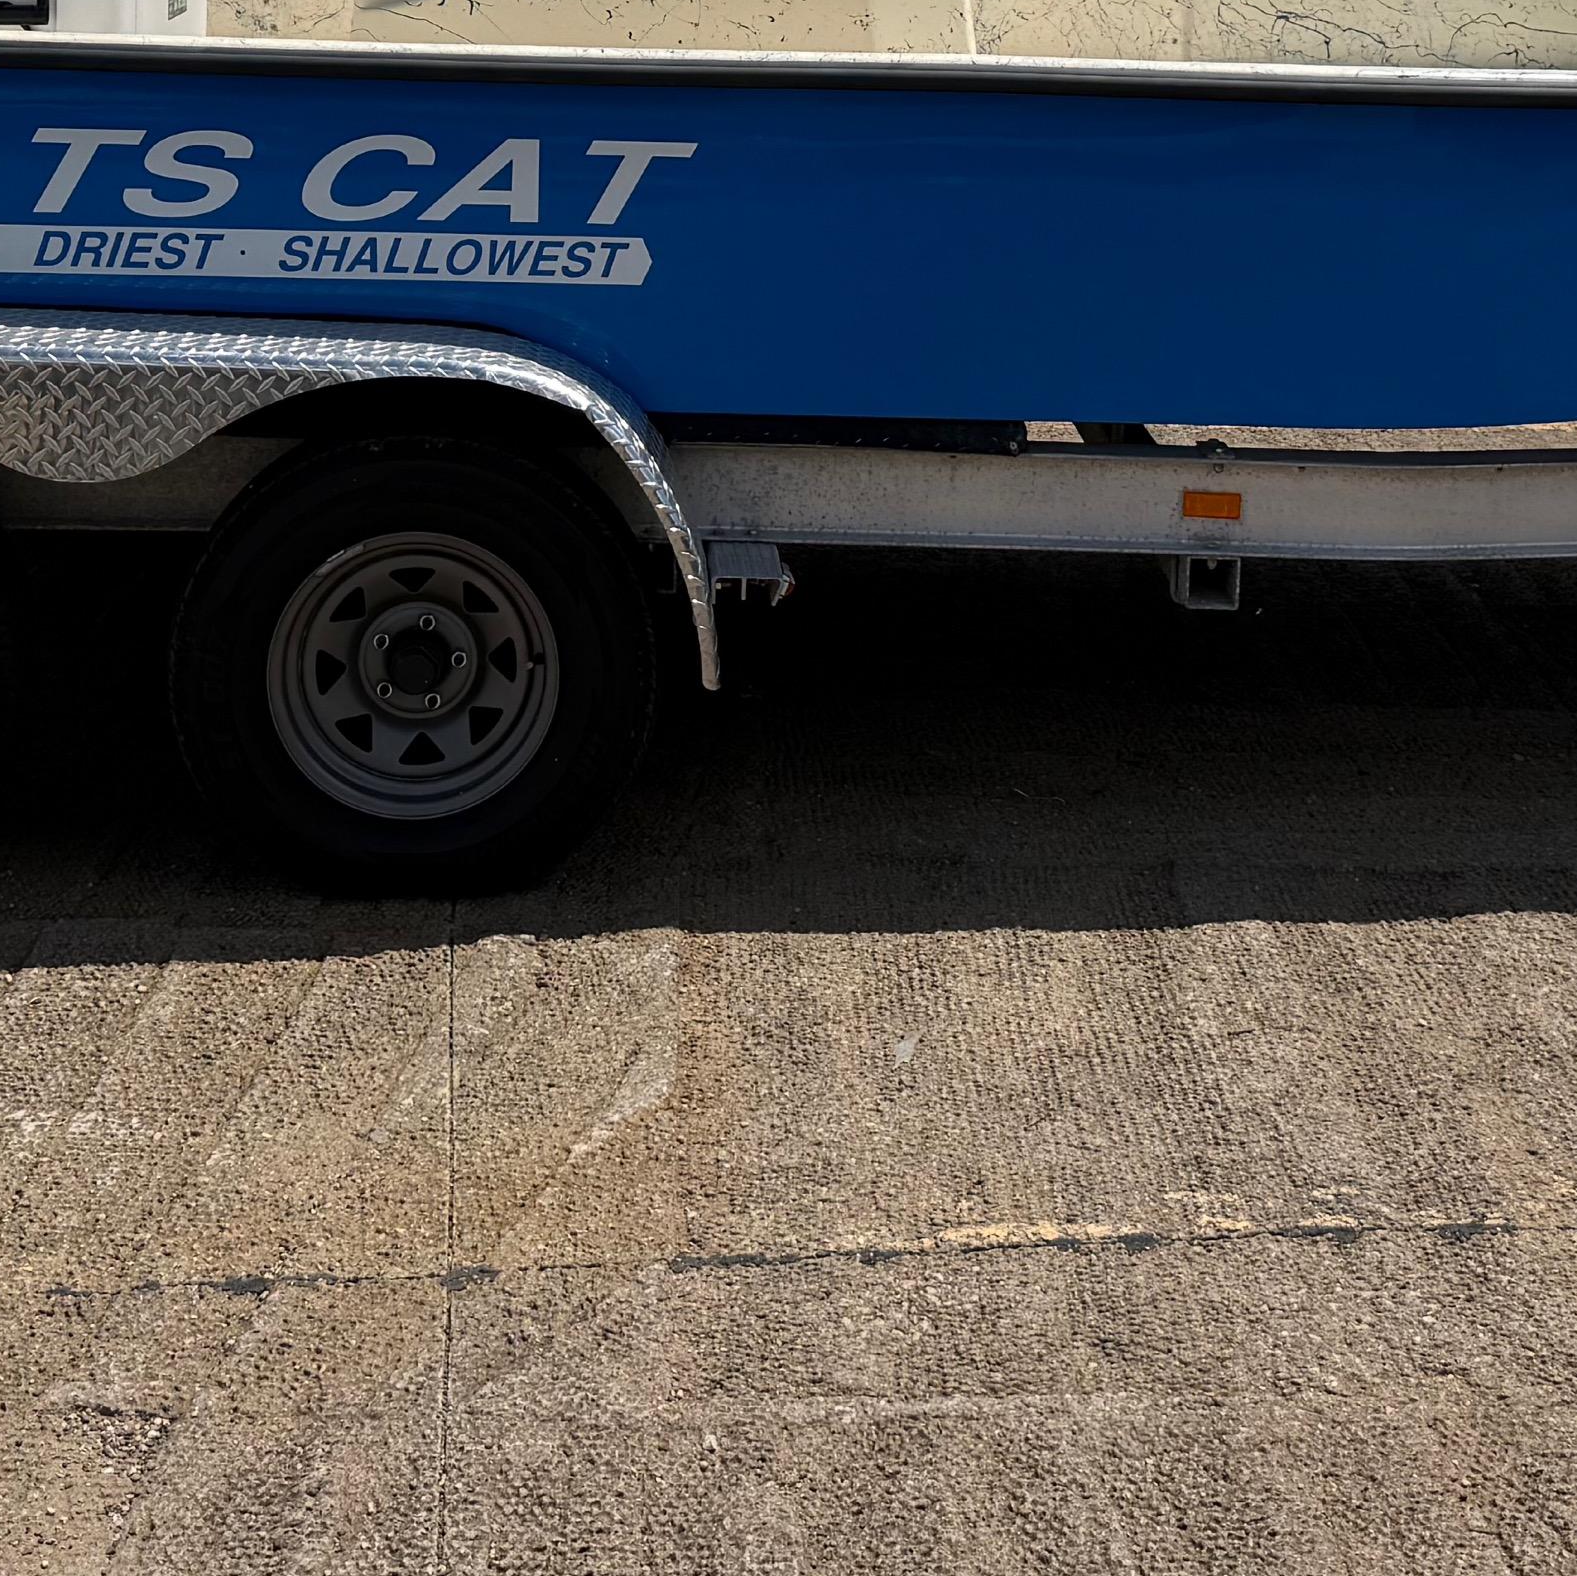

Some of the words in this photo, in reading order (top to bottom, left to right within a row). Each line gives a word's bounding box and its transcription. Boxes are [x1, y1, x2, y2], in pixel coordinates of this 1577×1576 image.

[301, 134, 699, 225] CAT
[33, 231, 225, 271] DRIEST
[277, 234, 631, 279] SHALLOWEST
